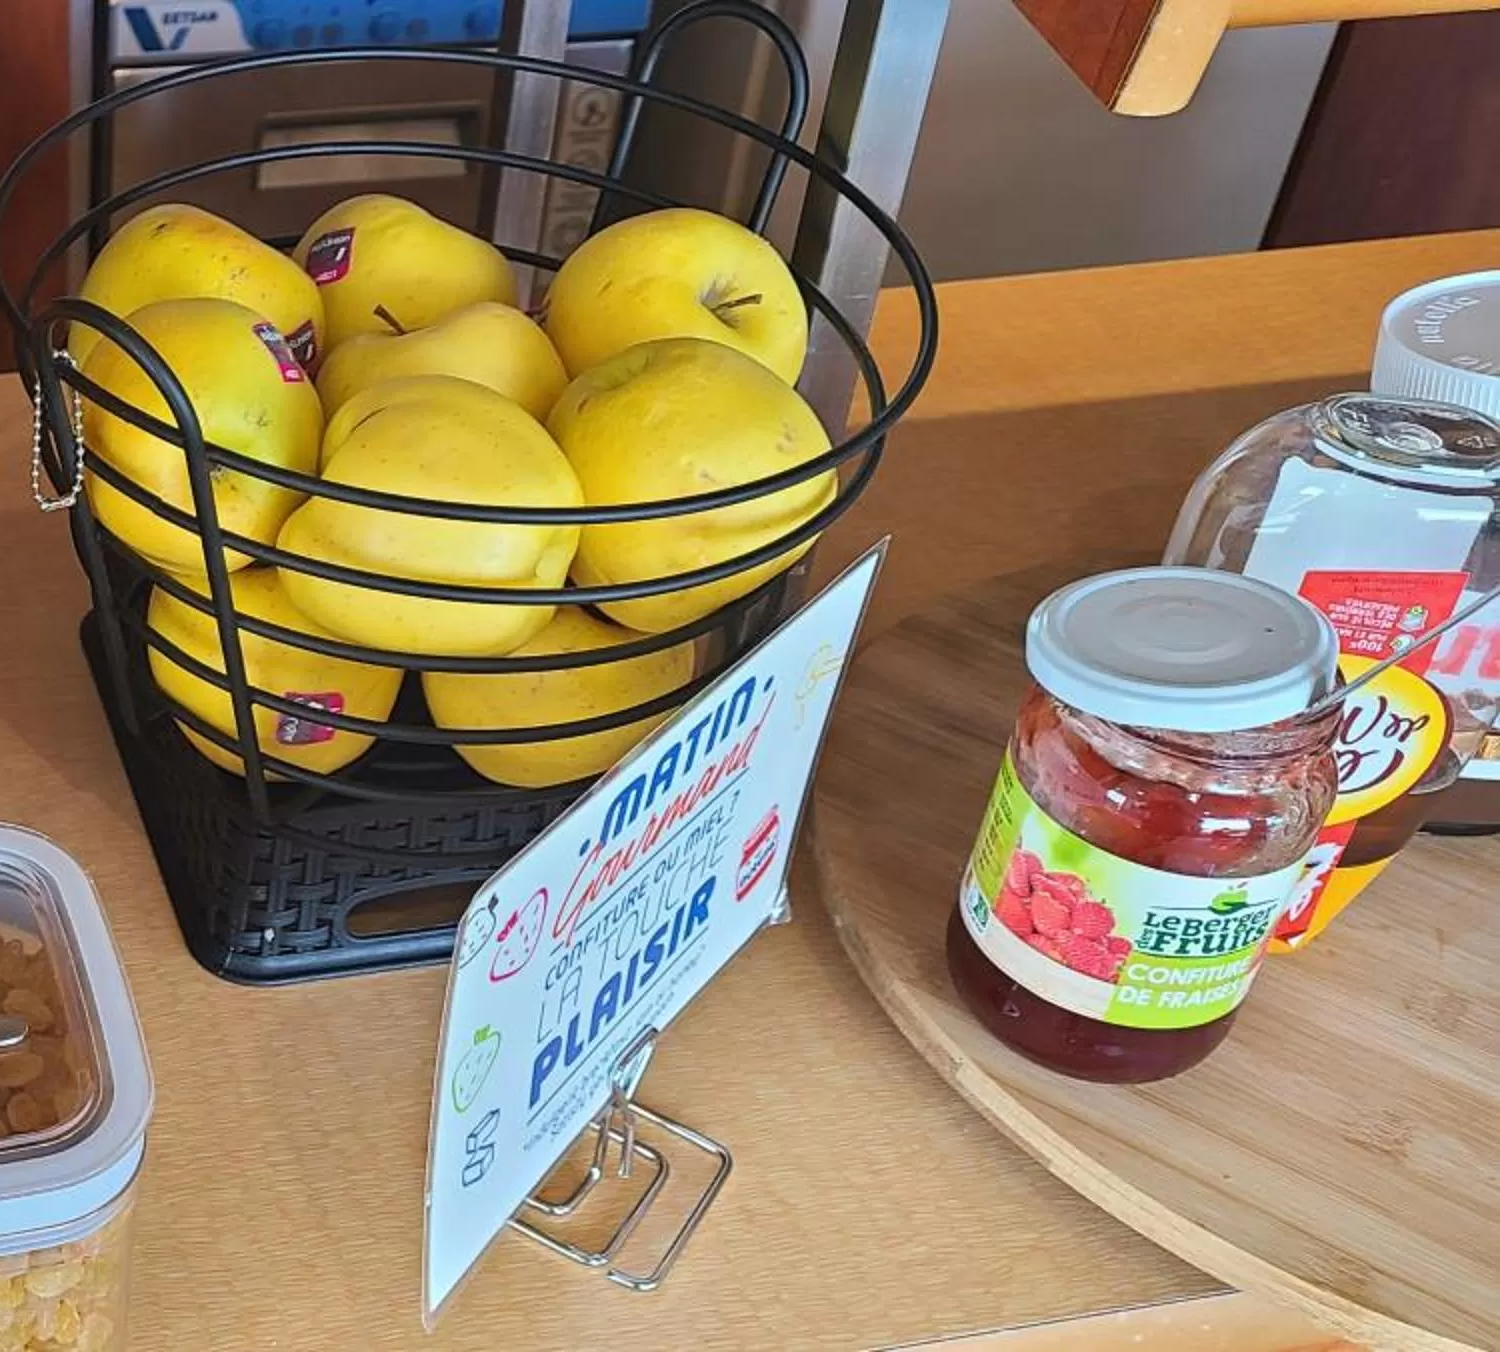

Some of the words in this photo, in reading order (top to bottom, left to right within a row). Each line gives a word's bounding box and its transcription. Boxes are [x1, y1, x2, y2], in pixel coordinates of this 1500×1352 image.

[553, 690, 776, 947] Gourmand
[600, 675, 756, 847] MATIN
[529, 874, 717, 1110] PLAISIR
[537, 965, 583, 1044] LA
[599, 814, 735, 980] TOUCHE
[545, 873, 651, 990] CONFITURE
[653, 845, 682, 884] OU
[1117, 984, 1152, 1006] DE
[1150, 922, 1270, 955] Fruits
